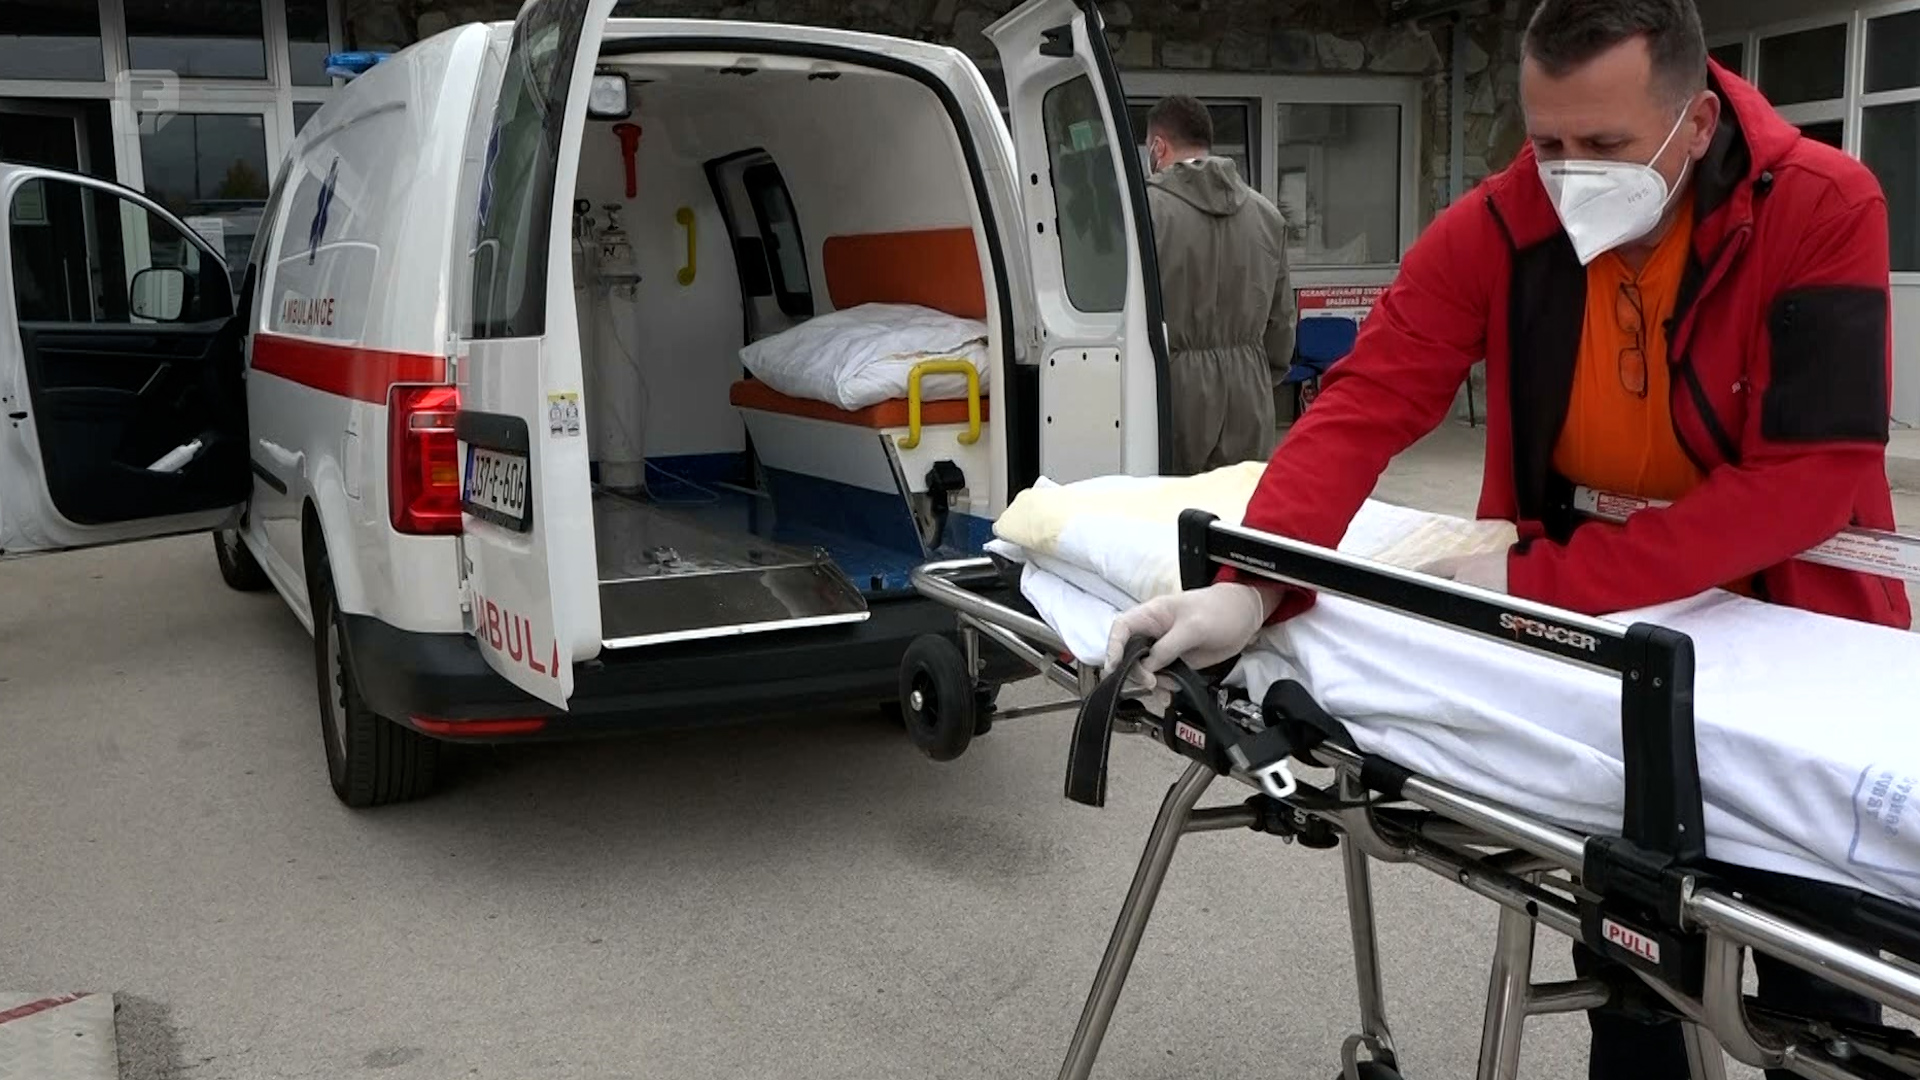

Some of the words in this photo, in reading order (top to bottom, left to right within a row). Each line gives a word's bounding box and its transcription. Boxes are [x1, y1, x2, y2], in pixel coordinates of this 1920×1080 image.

[282, 297, 335, 326] AMBULANCE
[1499, 612, 1596, 653] SPENCER
[1178, 725, 1204, 748] PULL
[1608, 924, 1656, 960] PULL
